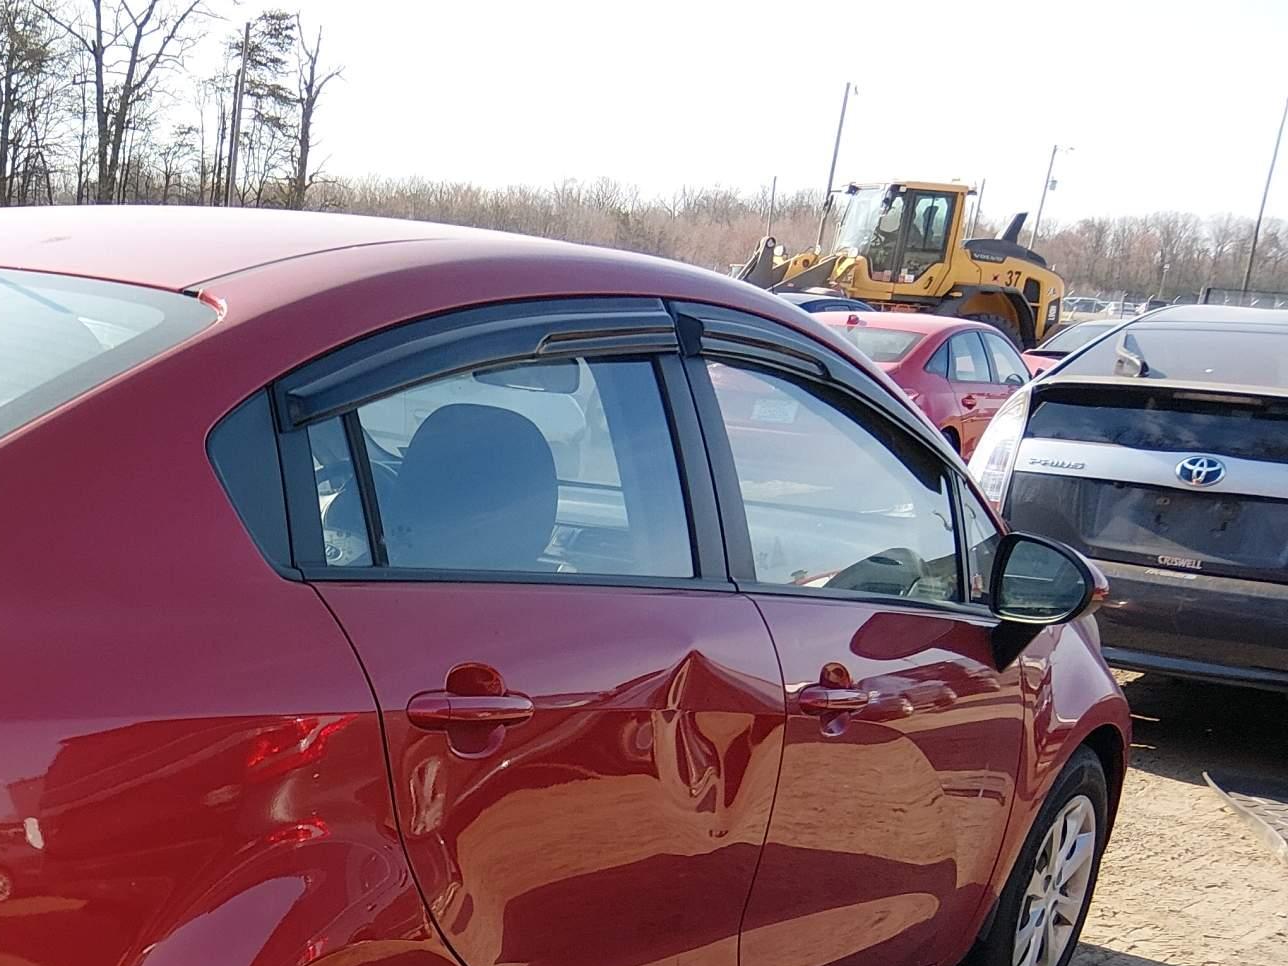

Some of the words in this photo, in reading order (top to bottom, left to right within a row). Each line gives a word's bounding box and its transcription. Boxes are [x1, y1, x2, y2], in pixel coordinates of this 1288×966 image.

[1004, 270, 1022, 288] 37
[1028, 457, 1086, 470] PRIUS
[1158, 555, 1202, 570] CRISWELL
